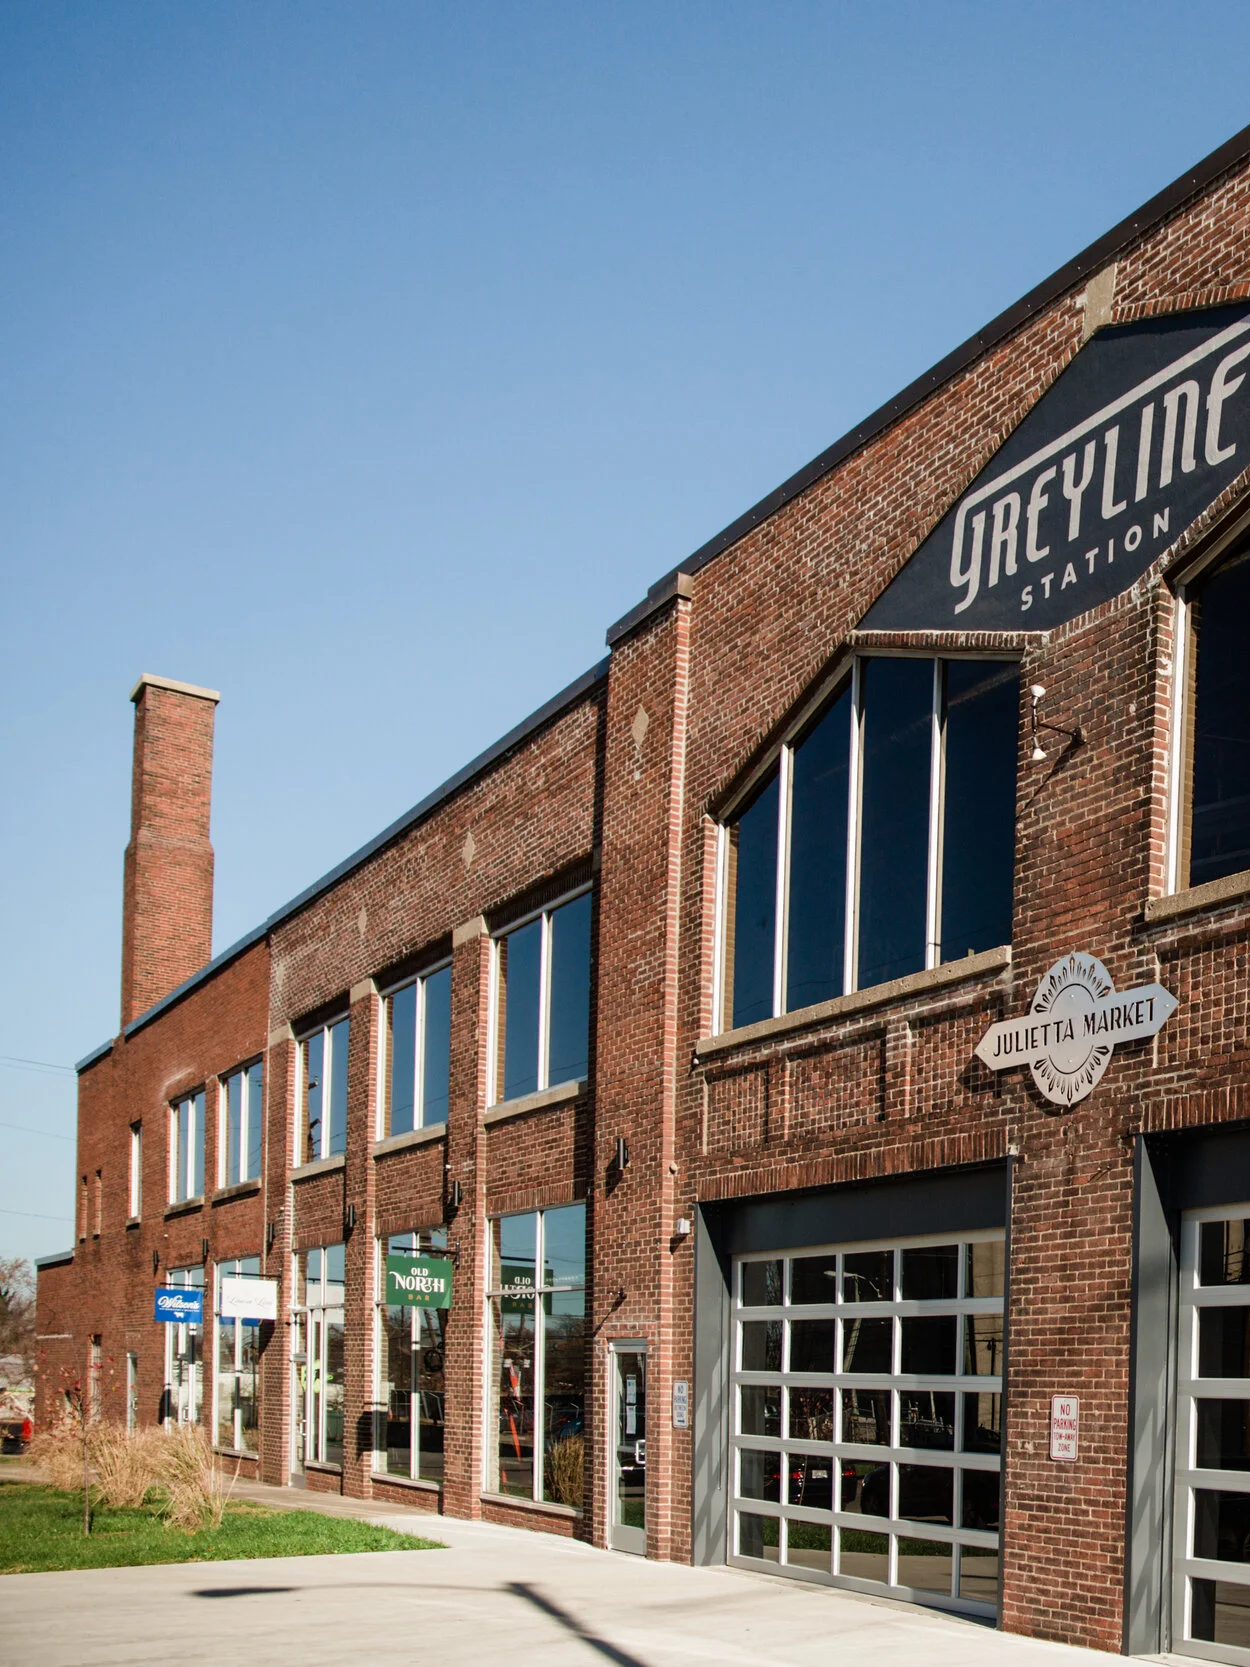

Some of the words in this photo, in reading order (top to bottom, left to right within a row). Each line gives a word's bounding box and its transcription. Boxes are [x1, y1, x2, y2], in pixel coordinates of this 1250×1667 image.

[1020, 507, 1170, 611] STATION
[993, 1019, 1075, 1057] JULIETTA
[1083, 997, 1157, 1037] MARKET
[411, 1267, 429, 1277] OLD
[389, 1271, 445, 1293] NORTH
[1060, 1404, 1071, 1416] NO
[1053, 1418, 1076, 1431] PARKING
[1058, 1443, 1071, 1452] ZONE
